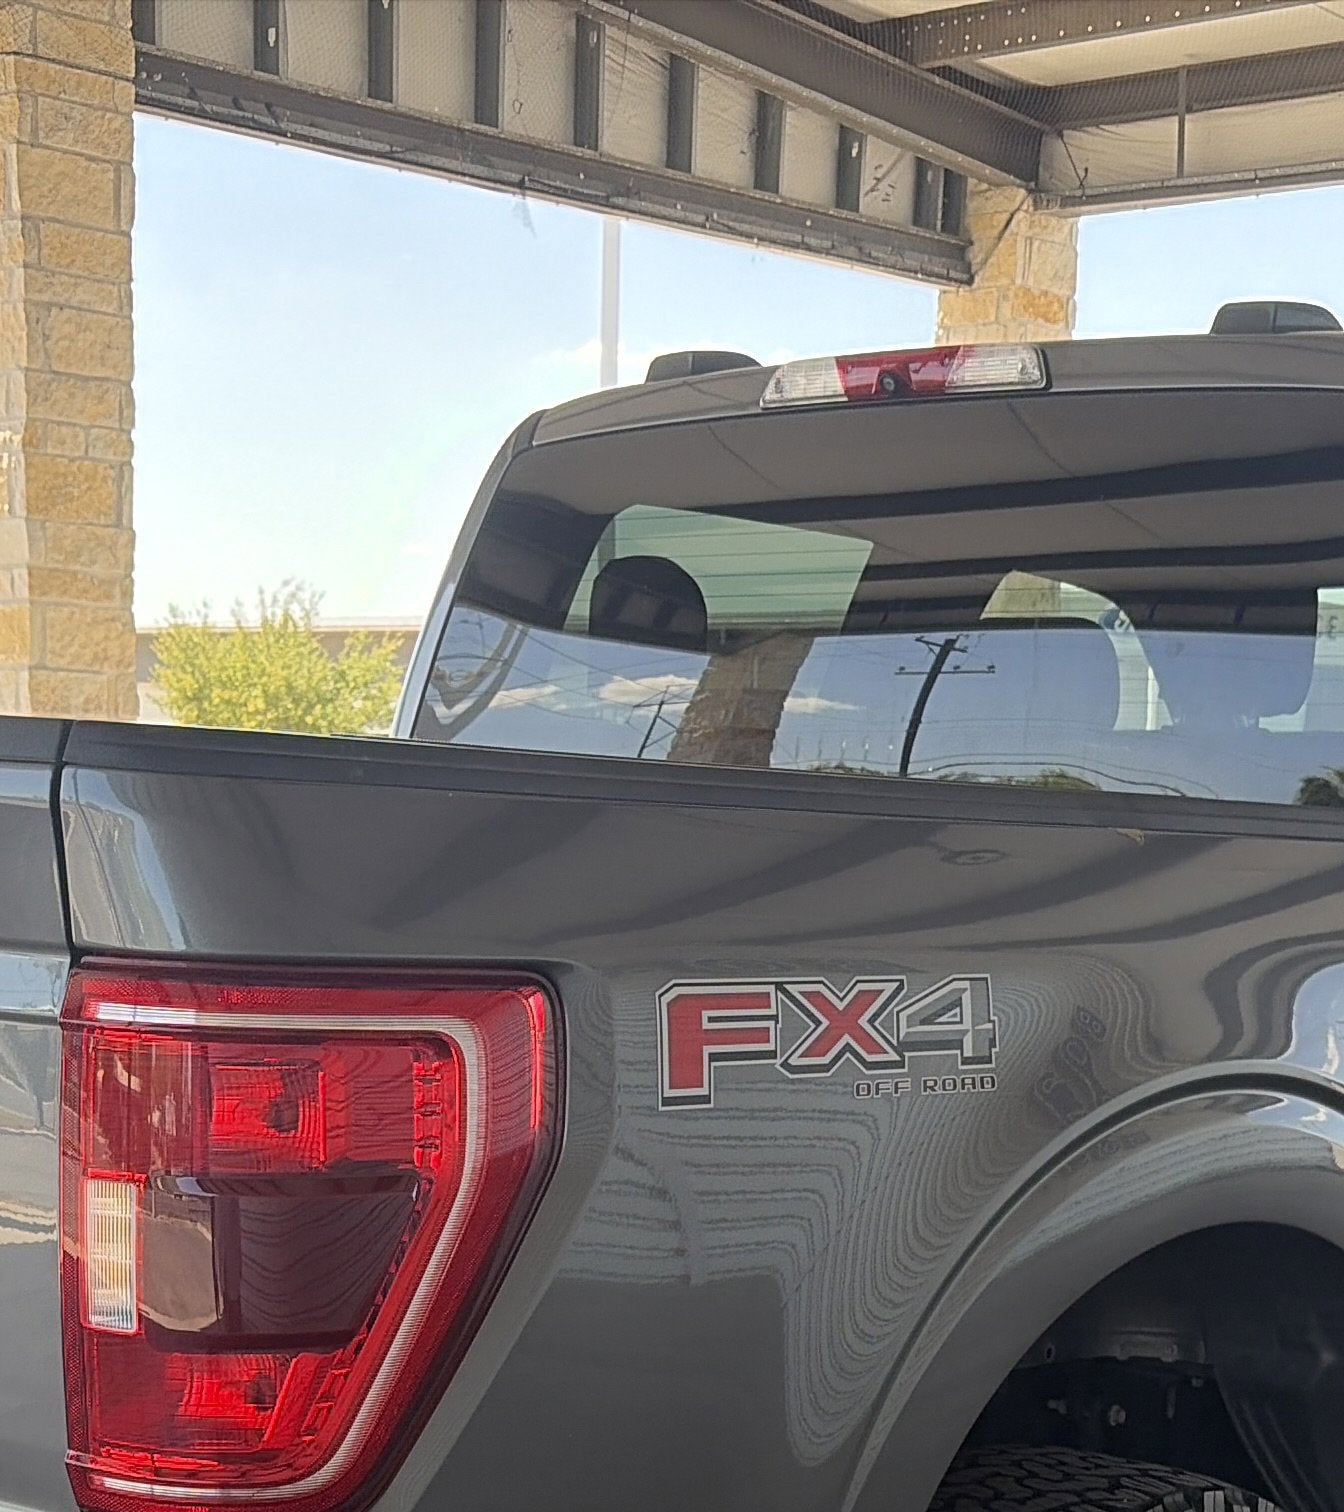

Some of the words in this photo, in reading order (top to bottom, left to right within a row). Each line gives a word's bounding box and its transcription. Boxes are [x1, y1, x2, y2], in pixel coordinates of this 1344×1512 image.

[655, 973, 1000, 1112] FX4
[854, 1077, 912, 1099] OFF
[921, 1073, 998, 1095] ROAD
